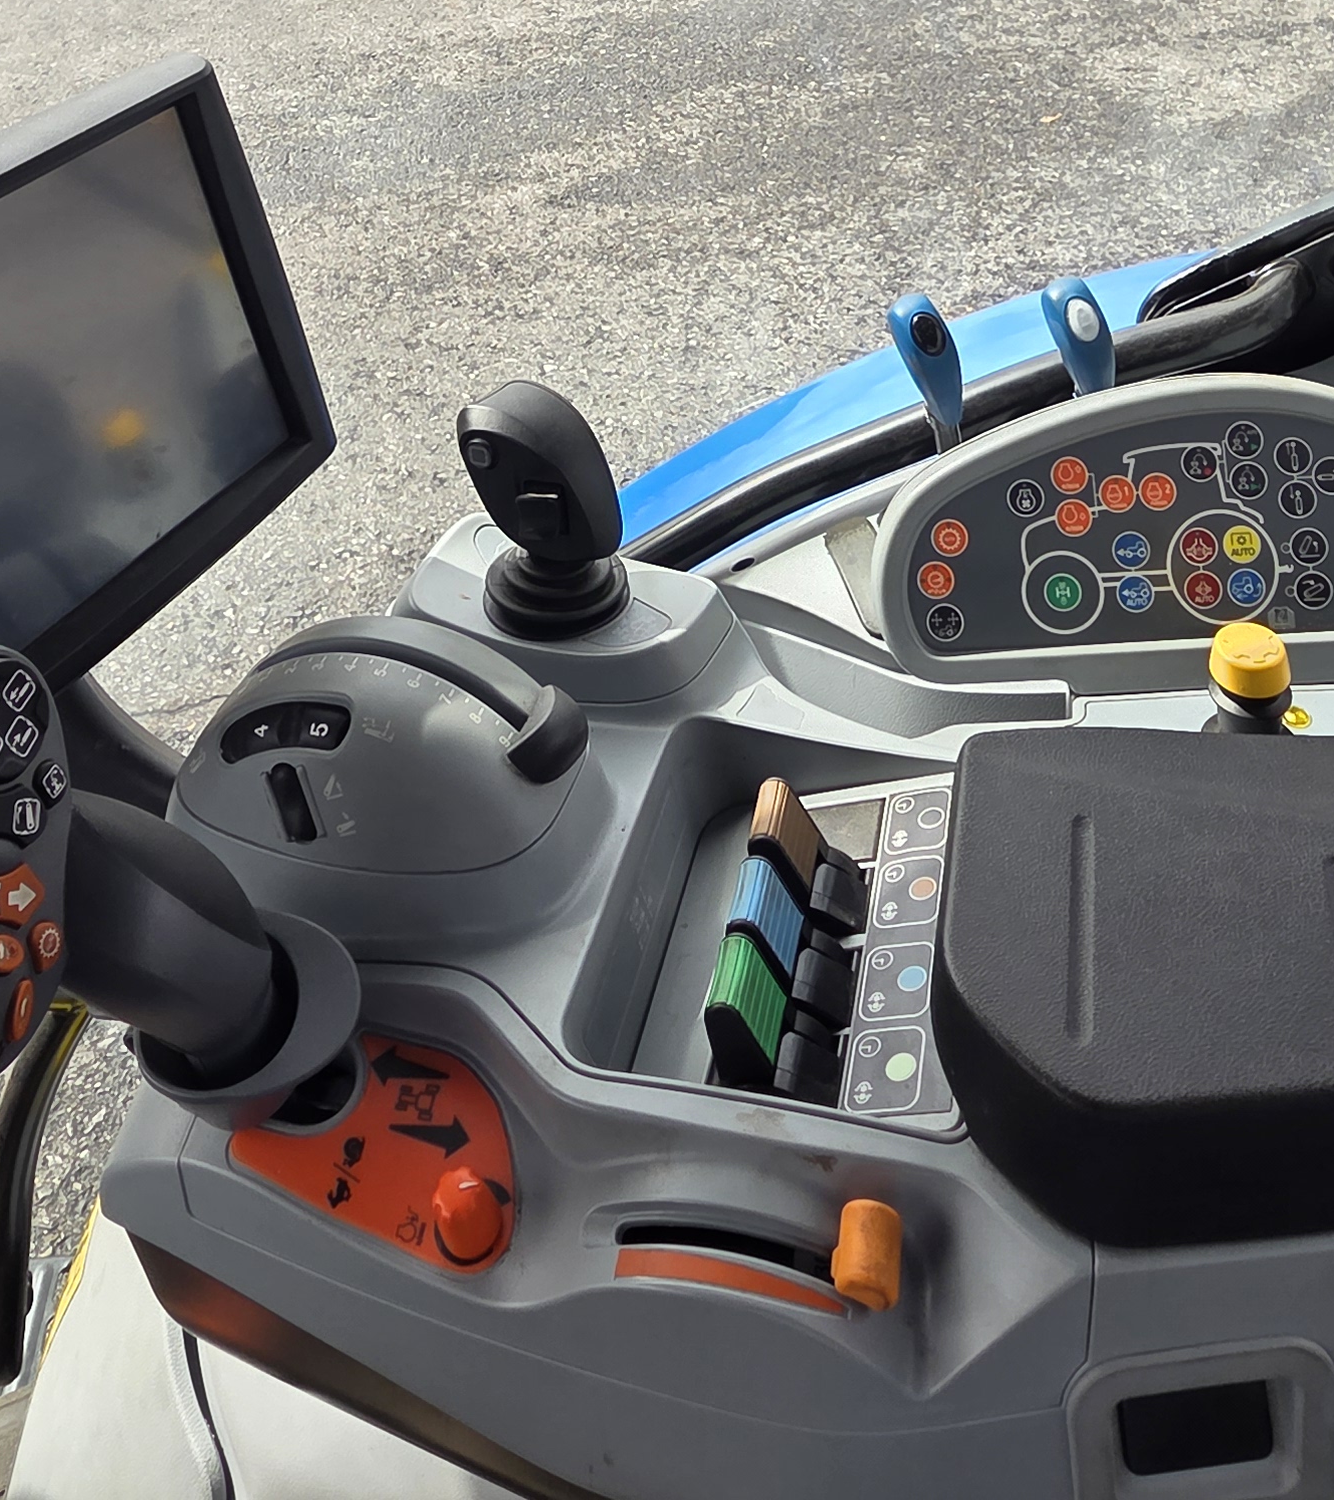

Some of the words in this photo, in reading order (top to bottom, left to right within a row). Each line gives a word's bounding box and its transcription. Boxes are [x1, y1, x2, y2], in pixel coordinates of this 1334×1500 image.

[1123, 485, 1130, 497] 1
[1165, 483, 1172, 494] 2
[1231, 546, 1257, 557] AUTO
[1126, 597, 1148, 607] AUTO
[1194, 595, 1215, 603] AUTO
[373, 667, 387, 677] 5
[406, 678, 420, 688] 6
[438, 693, 451, 705] 7
[469, 712, 482, 724] 8
[498, 735, 511, 748] 9
[254, 724, 269, 737] 4
[309, 722, 329, 737] 5
